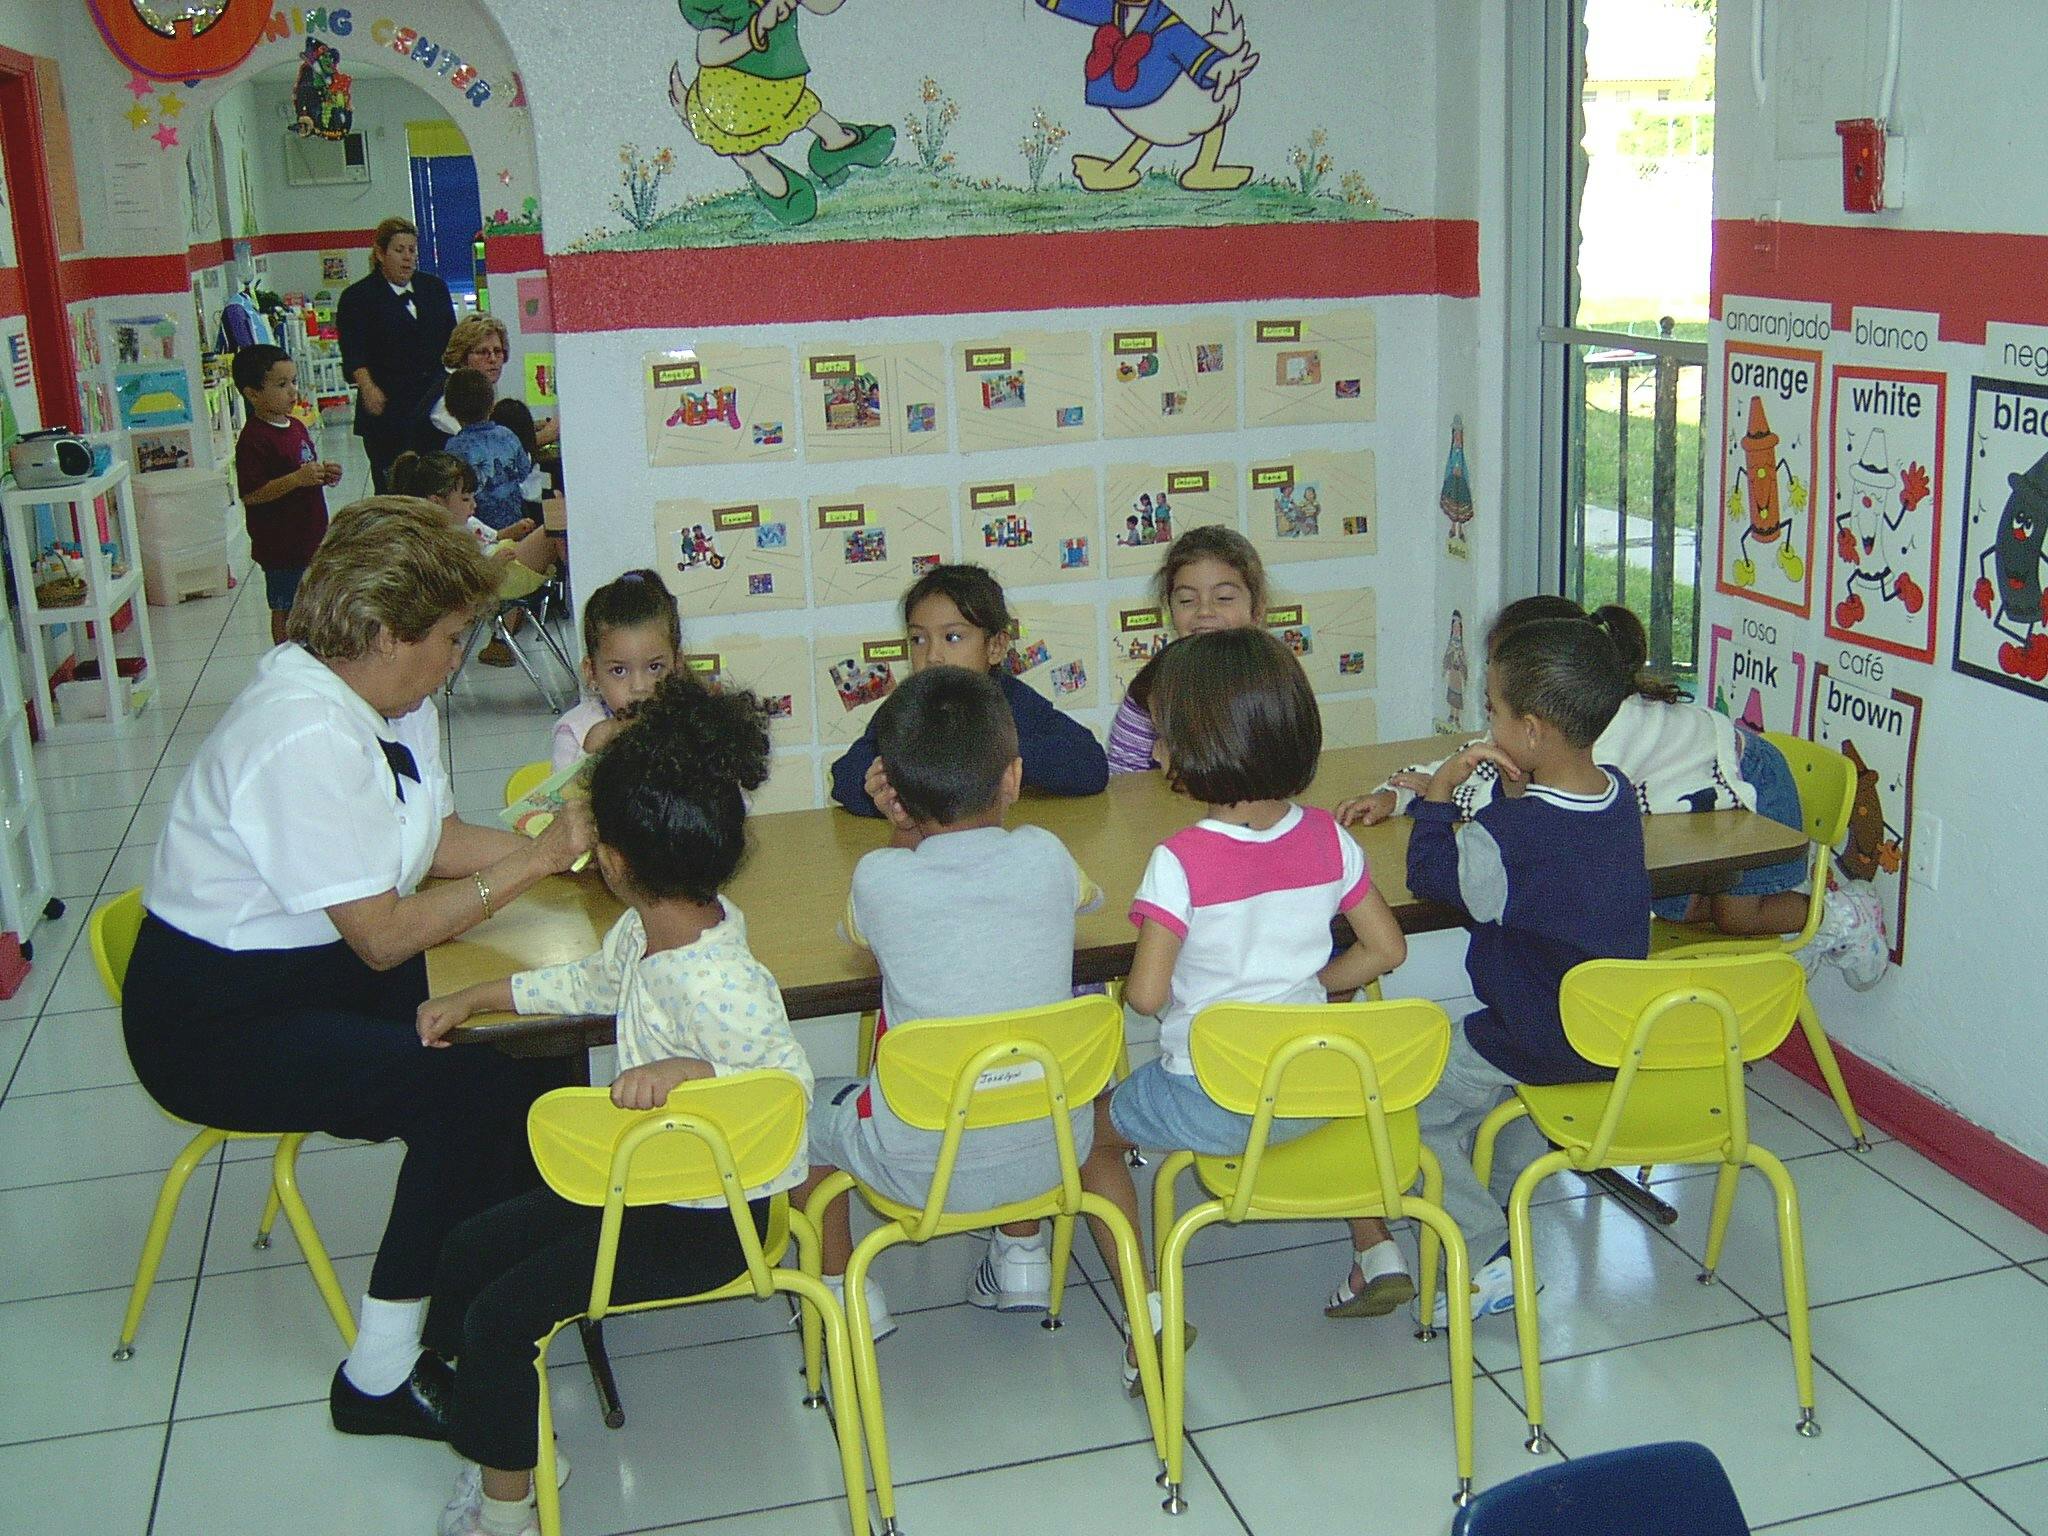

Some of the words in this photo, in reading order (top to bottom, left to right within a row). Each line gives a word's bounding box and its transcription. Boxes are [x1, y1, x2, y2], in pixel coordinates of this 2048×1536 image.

[370, 17, 492, 108] CENTER
[1726, 309, 1831, 343] anaranjado
[1855, 318, 1929, 353] blanco
[2003, 341, 2048, 377] neg
[1731, 358, 1809, 400] orange
[1852, 382, 1921, 419] white
[1742, 617, 1777, 645] rosa
[1732, 650, 1779, 689] pink
[1838, 649, 1885, 682] café
[1827, 680, 1903, 736] brown
